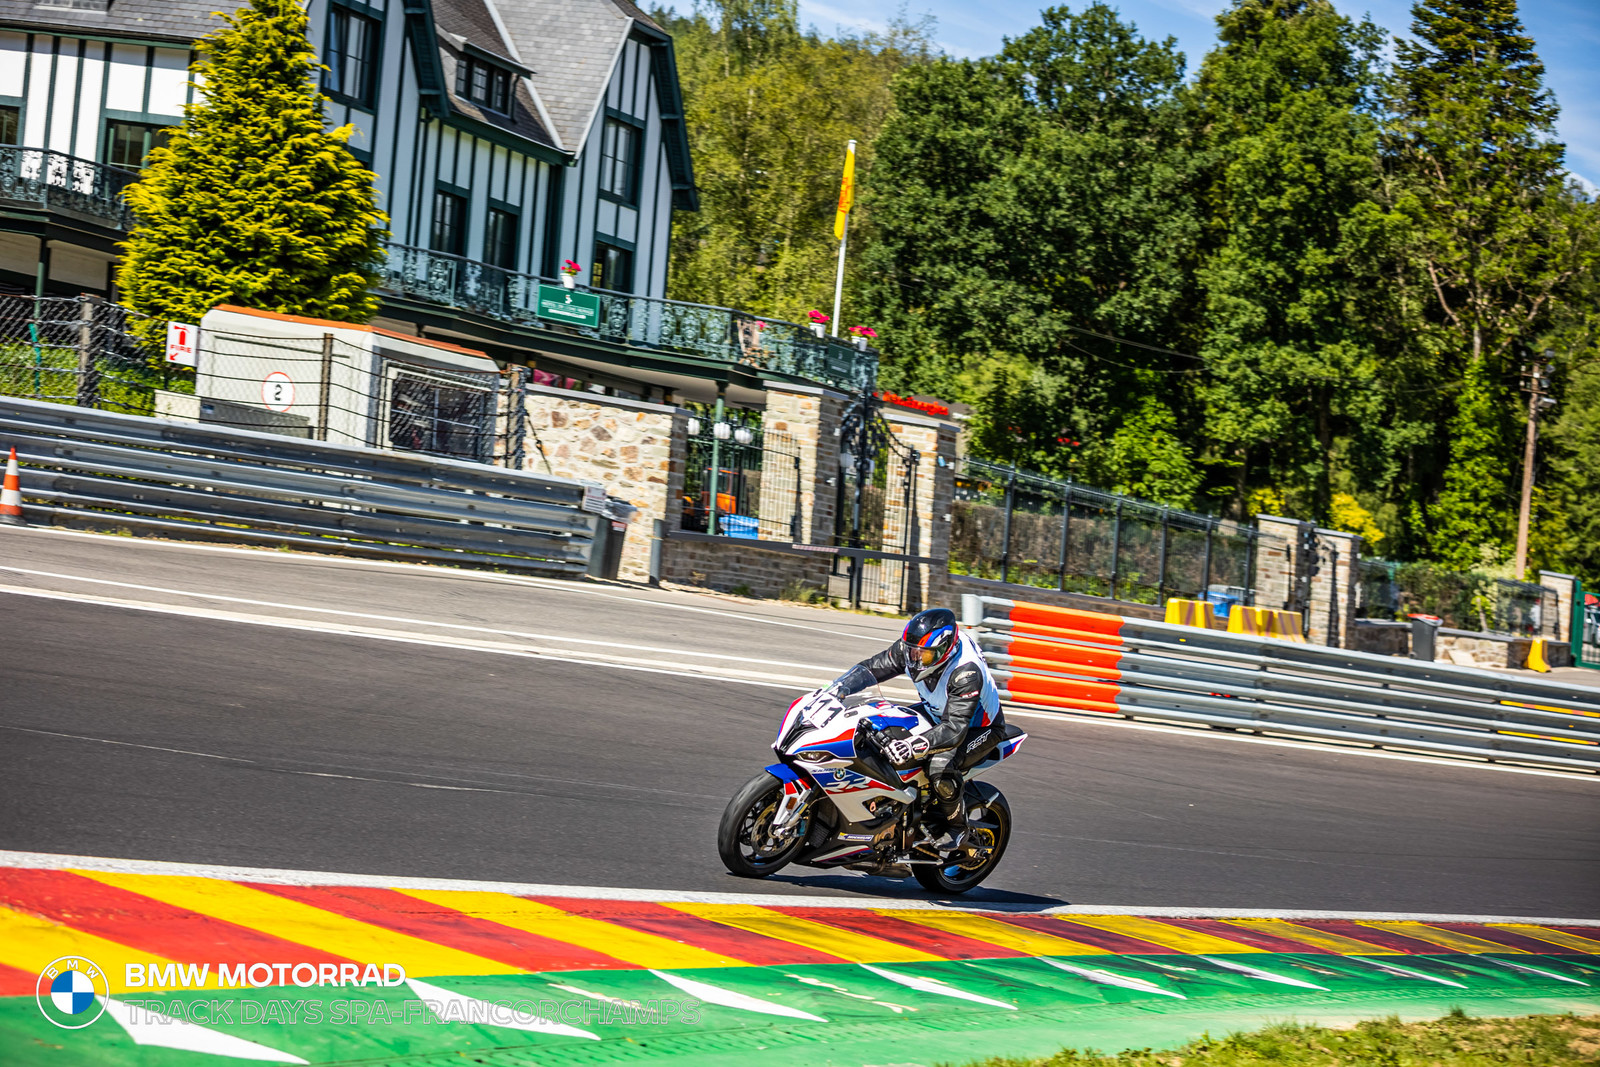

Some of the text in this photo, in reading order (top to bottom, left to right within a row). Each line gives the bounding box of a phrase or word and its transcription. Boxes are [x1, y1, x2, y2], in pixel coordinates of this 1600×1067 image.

[170, 344, 192, 354] FIRE
[274, 384, 283, 401] 2
[966, 729, 991, 754] RST
